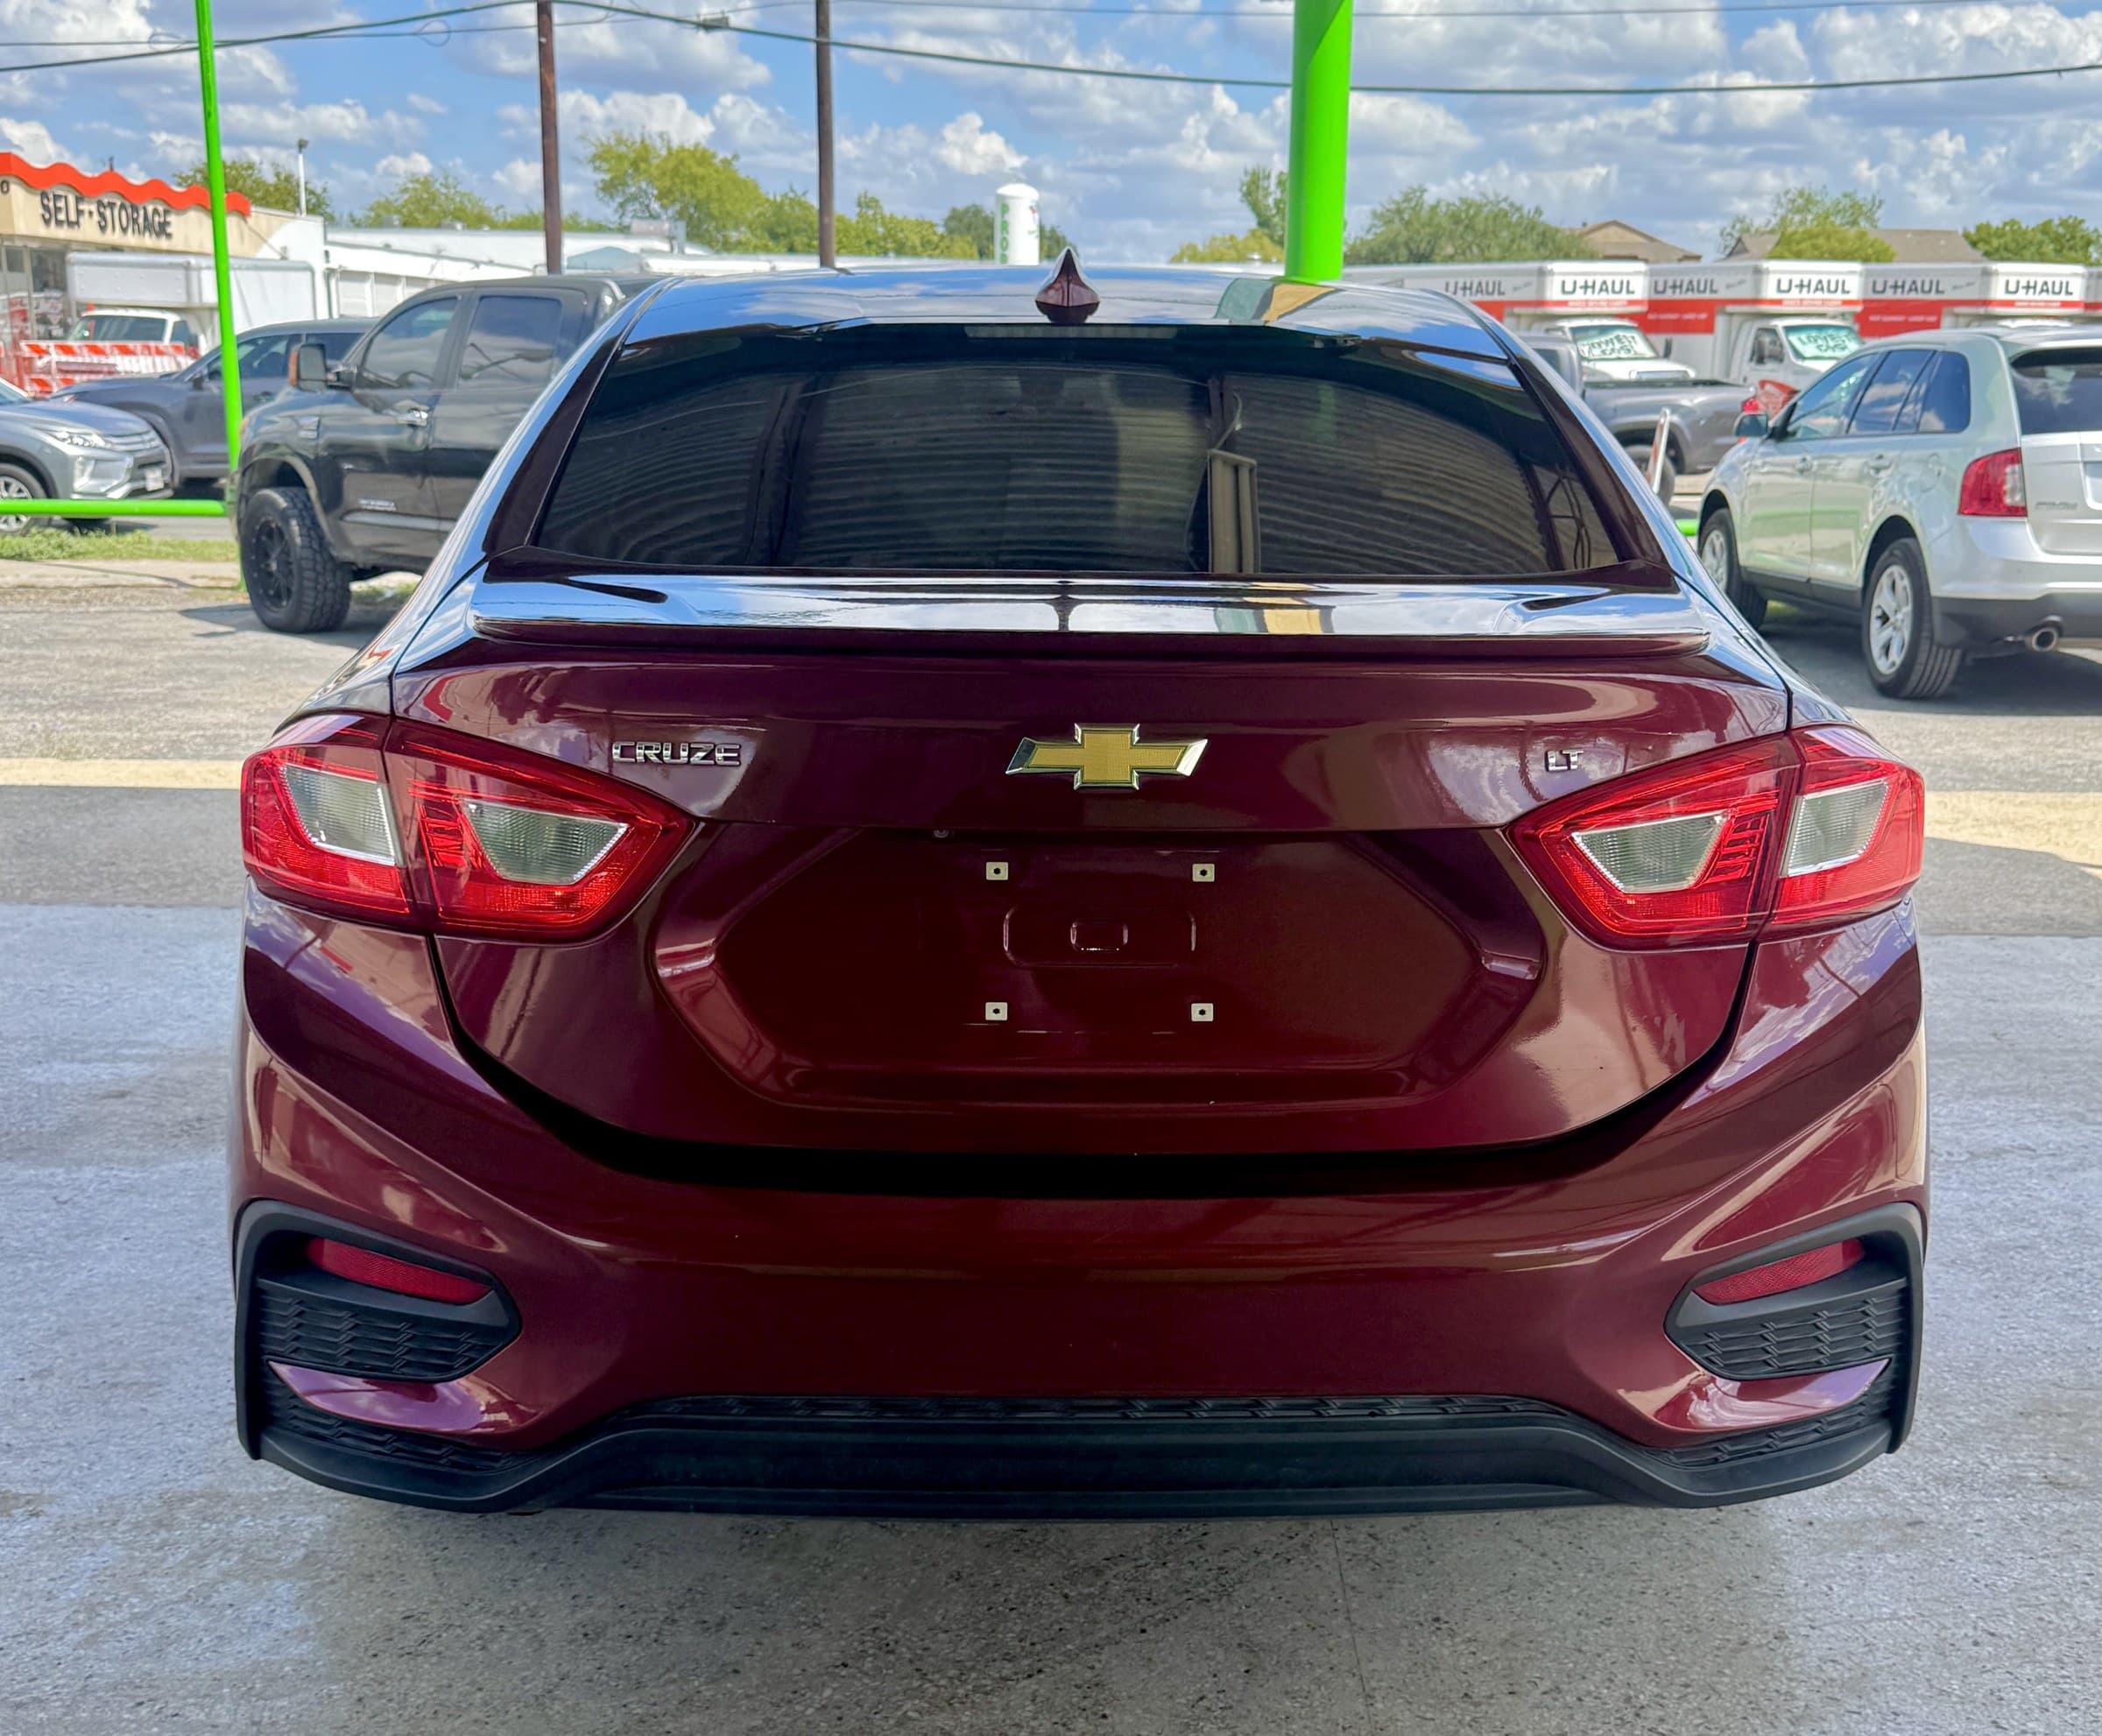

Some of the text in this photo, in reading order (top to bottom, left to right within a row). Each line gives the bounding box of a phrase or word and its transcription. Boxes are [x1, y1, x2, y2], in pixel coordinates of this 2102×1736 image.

[1560, 279, 1635, 295] U-HAUL
[1653, 279, 1718, 294] U-HAUL
[1775, 277, 1851, 295] U-HAUL
[1872, 279, 1945, 294] U-HAUL
[2004, 279, 2074, 296] U-HAUL
[612, 741, 740, 766] CRUZE
[1545, 749, 1584, 771] LT
